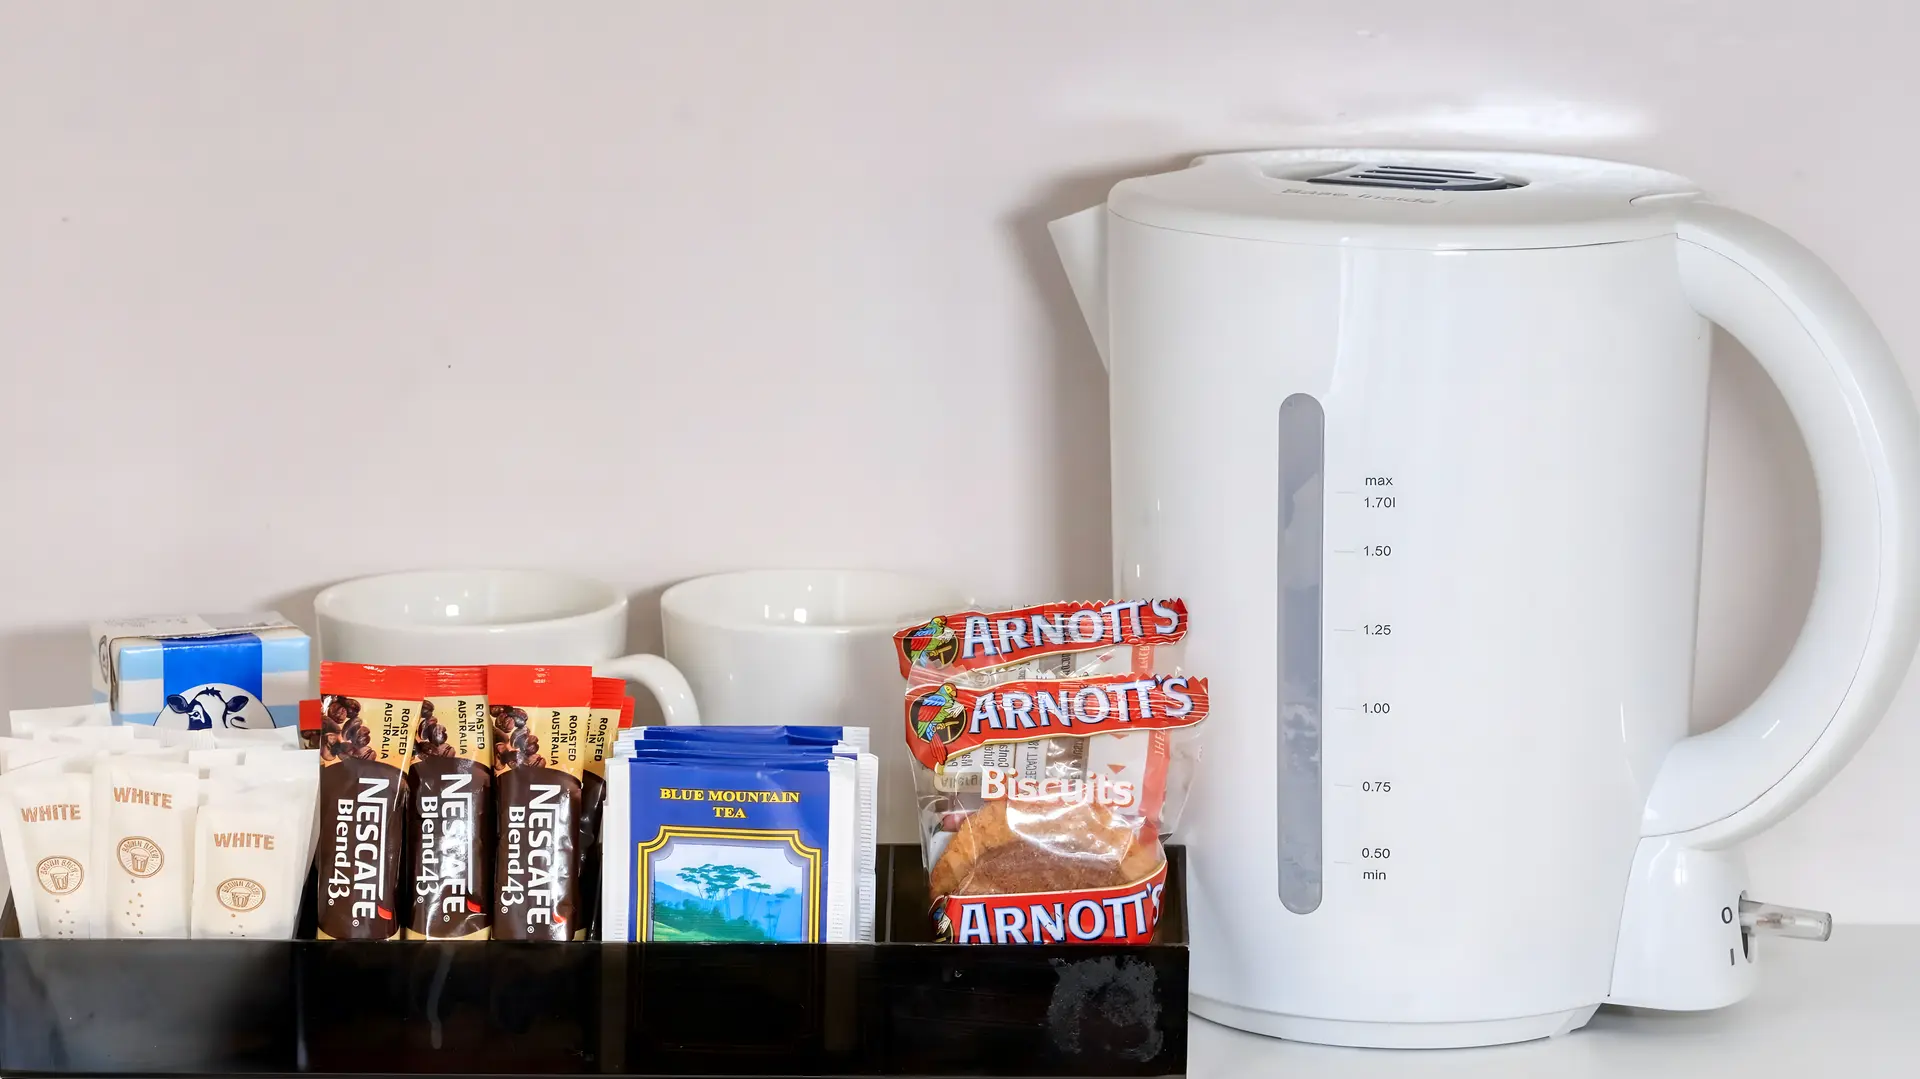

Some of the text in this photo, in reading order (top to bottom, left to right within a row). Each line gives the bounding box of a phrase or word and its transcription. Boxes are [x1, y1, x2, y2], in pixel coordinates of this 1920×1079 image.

[1365, 477, 1393, 486] max
[1363, 545, 1391, 556] 1.50
[1363, 624, 1391, 635] 1.25
[968, 674, 1195, 735] ARNOTT'S
[1362, 703, 1390, 714] 1.00
[380, 702, 393, 760] AUSTRALIA
[391, 725, 400, 737] IN
[398, 708, 410, 756] ROASTED
[457, 700, 468, 756] AUSTRALIA
[468, 721, 476, 732] IN
[475, 703, 485, 750] ROASTED
[550, 710, 561, 766] AUSTRALIA
[560, 733, 568, 743] IN
[567, 715, 578, 762] ROASTED
[588, 733, 597, 744] IN
[594, 717, 608, 762] ROASTED
[981, 767, 1135, 808] Biscuits
[1362, 781, 1391, 792] 0.75
[114, 786, 173, 809] WHITE
[660, 788, 800, 803] BLUE MOUNTAIN
[21, 804, 81, 822] WHITE
[713, 806, 746, 818] TEA
[213, 832, 275, 850] WHITE
[1361, 847, 1390, 859] 0.50
[1363, 869, 1387, 880] min
